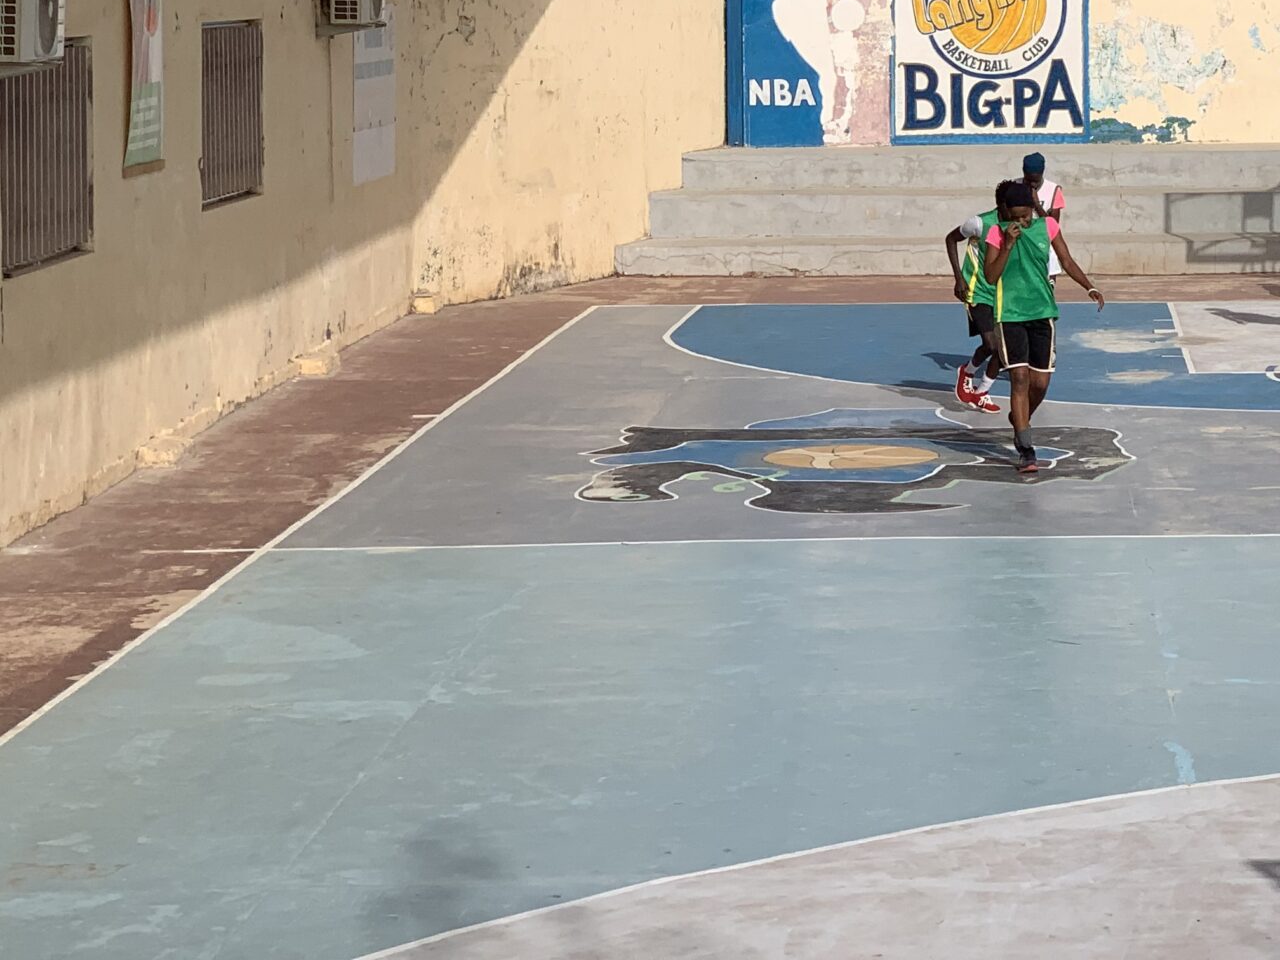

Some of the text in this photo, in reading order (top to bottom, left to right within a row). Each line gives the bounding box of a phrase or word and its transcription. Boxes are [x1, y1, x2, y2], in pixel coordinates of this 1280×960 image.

[942, 36, 1050, 72] BASKETBALL CLUB
[748, 78, 818, 107] NBA
